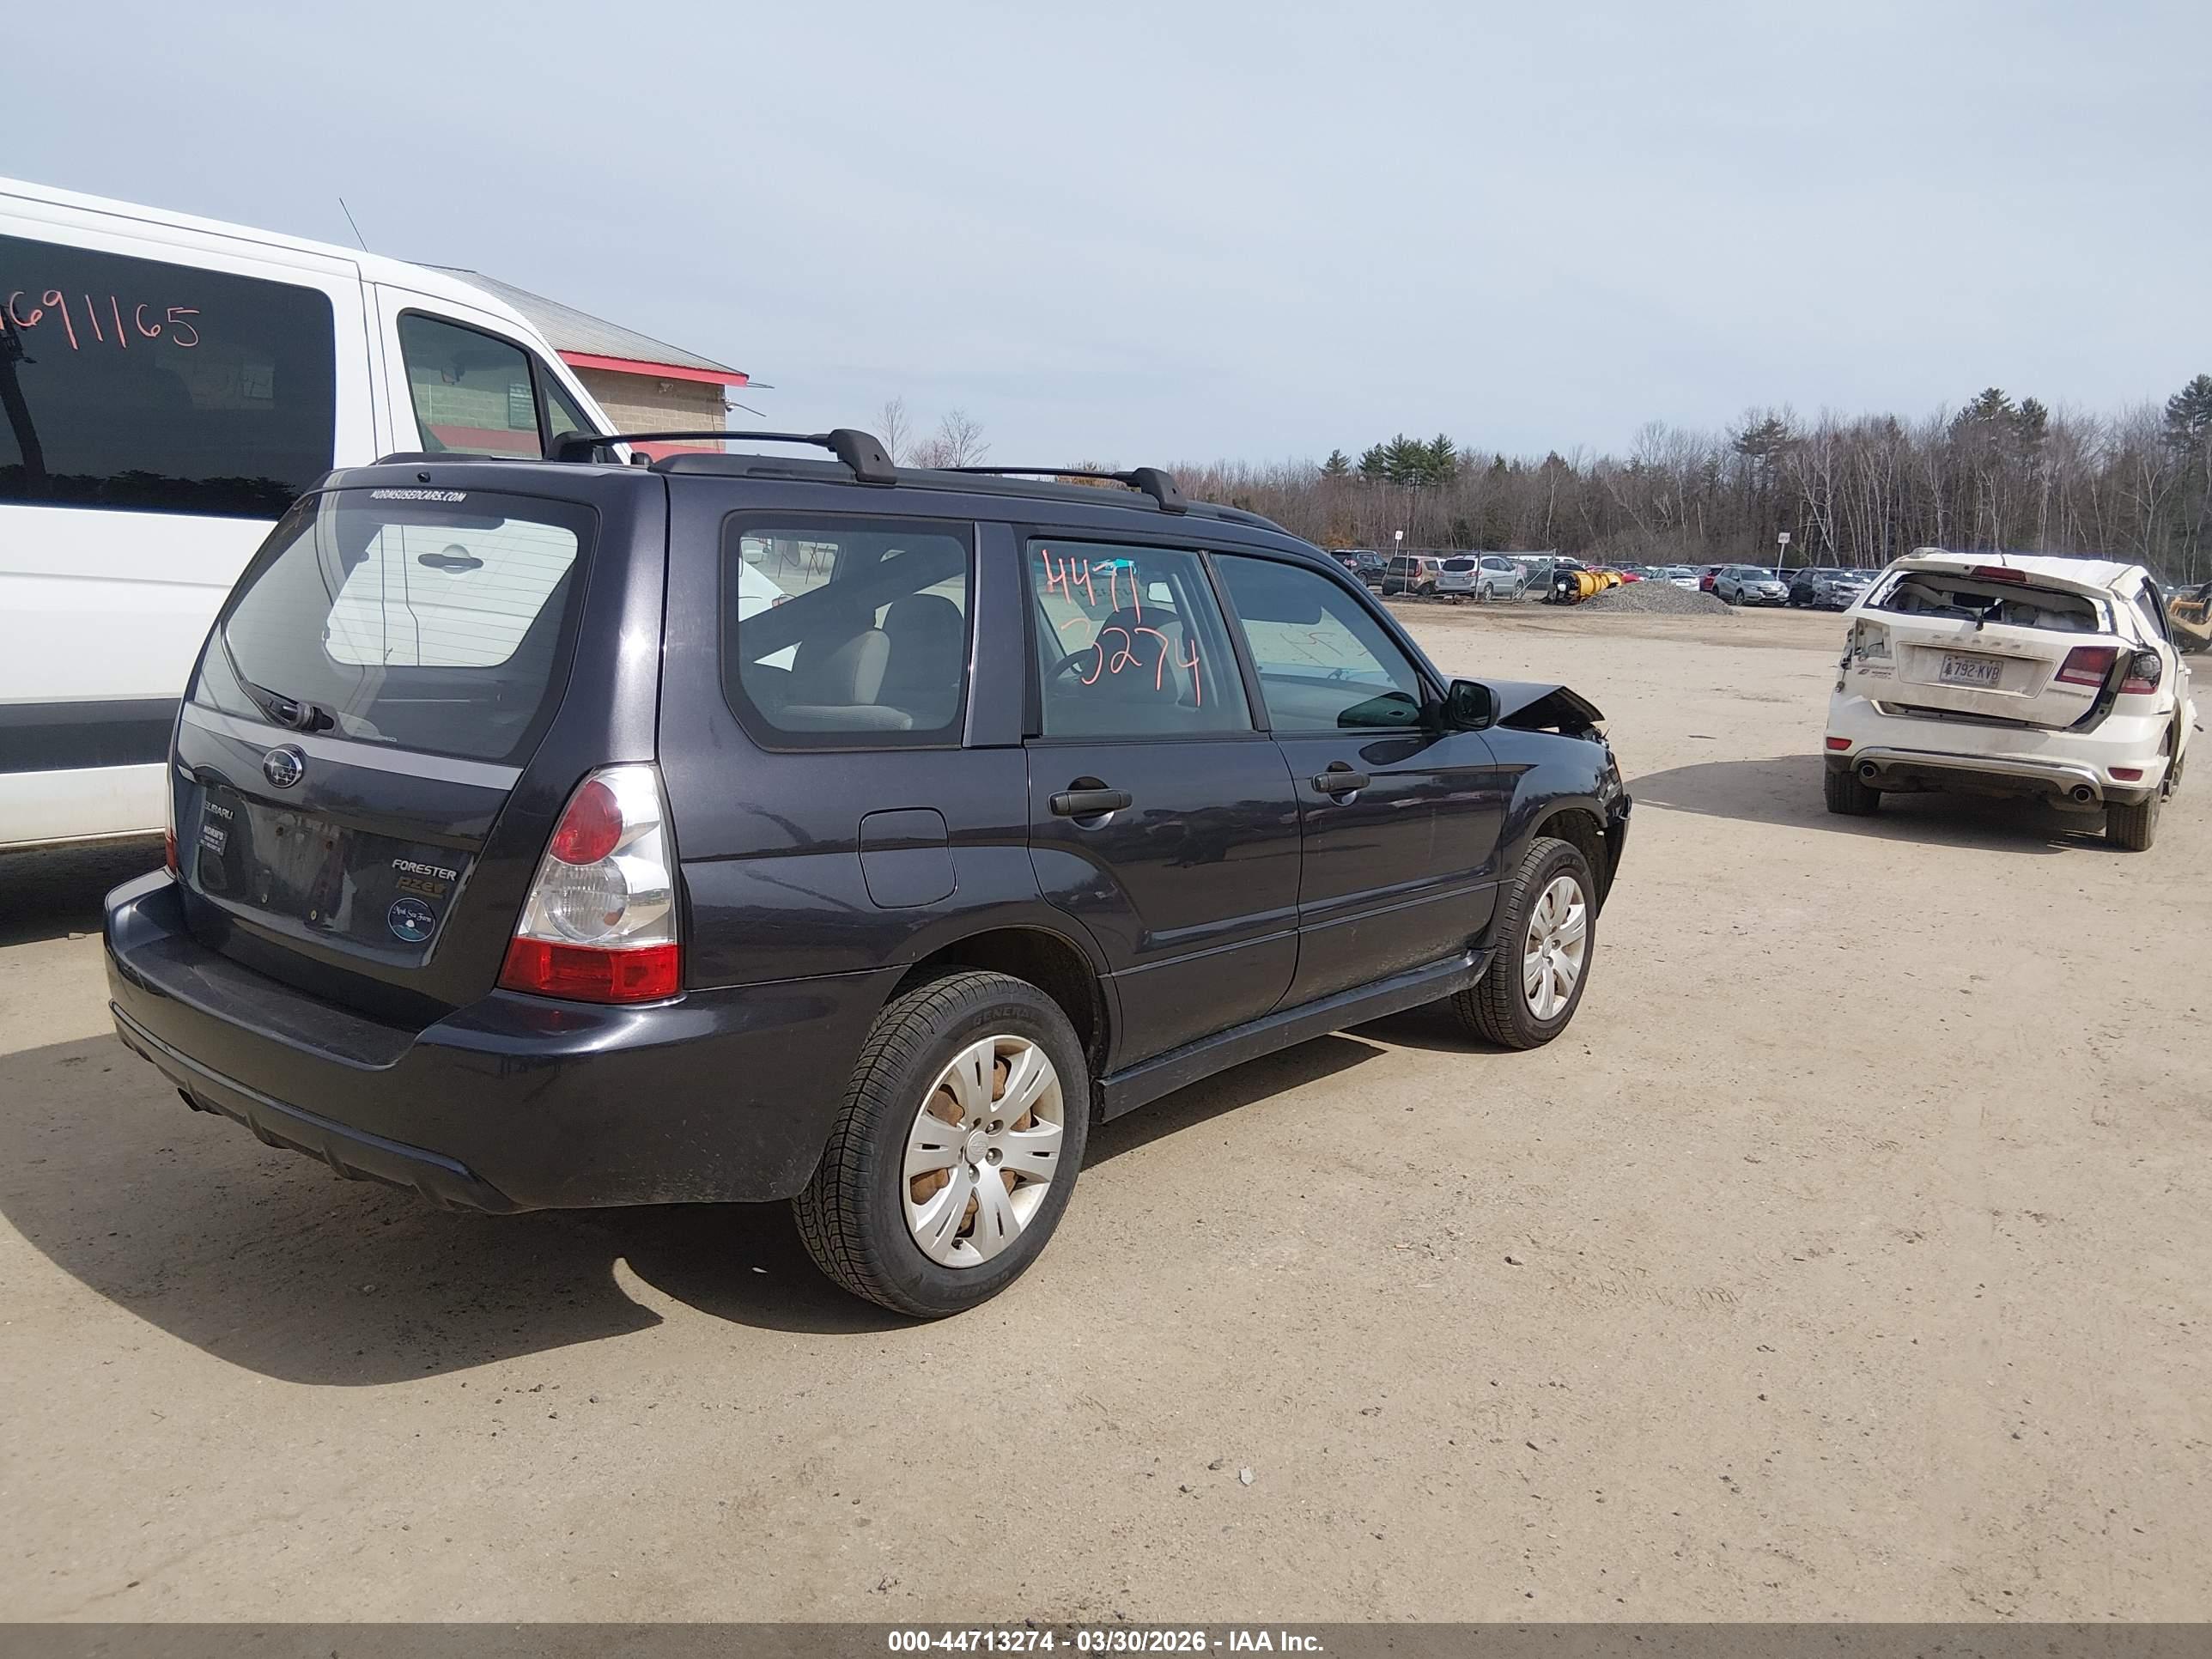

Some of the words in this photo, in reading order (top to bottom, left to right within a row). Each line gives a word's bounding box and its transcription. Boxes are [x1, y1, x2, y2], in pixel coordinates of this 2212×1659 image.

[0, 289, 200, 351] 691165
[370, 489, 467, 502] NORMSUSEDCARS.COM
[1954, 661, 2000, 681] 792-KVB
[392, 859, 458, 882] FORESTER
